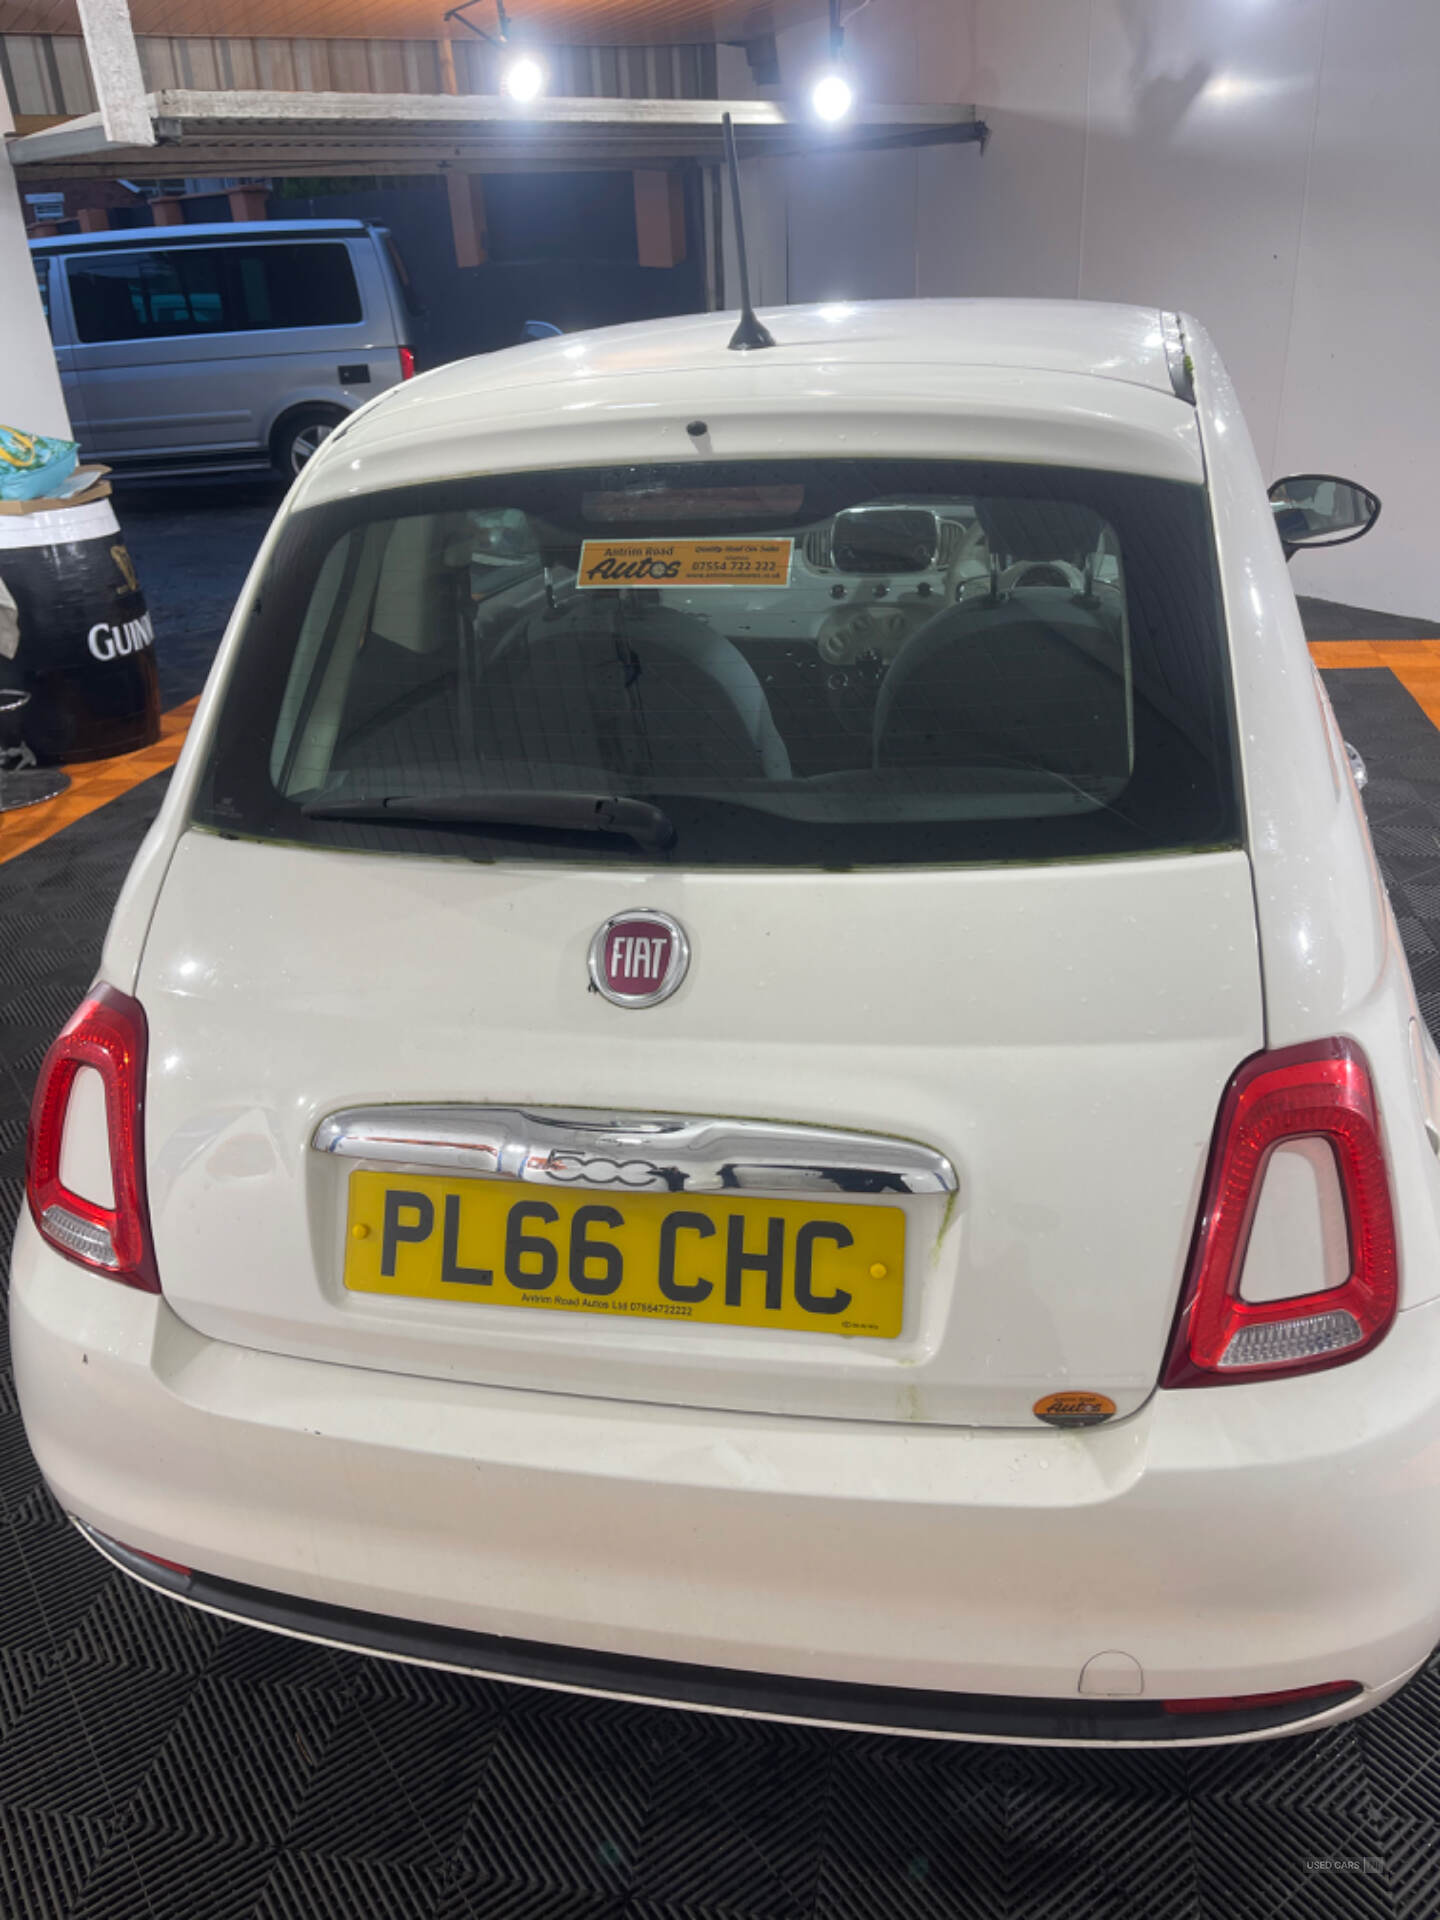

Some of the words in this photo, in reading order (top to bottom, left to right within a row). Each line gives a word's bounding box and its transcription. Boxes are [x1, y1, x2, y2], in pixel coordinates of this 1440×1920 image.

[604, 547, 642, 557] Antrim
[645, 546, 674, 556] Road
[586, 557, 682, 580] Autos
[691, 561, 727, 571] 07554
[730, 561, 752, 571] 722
[755, 561, 777, 571] 222
[610, 936, 668, 979] FIAT
[545, 1148, 658, 1187] 500
[380, 1189, 626, 1297] PL66
[658, 1210, 855, 1315] CHC
[521, 1292, 553, 1304] Antrim
[554, 1295, 580, 1307] Road
[581, 1298, 610, 1310] Autos
